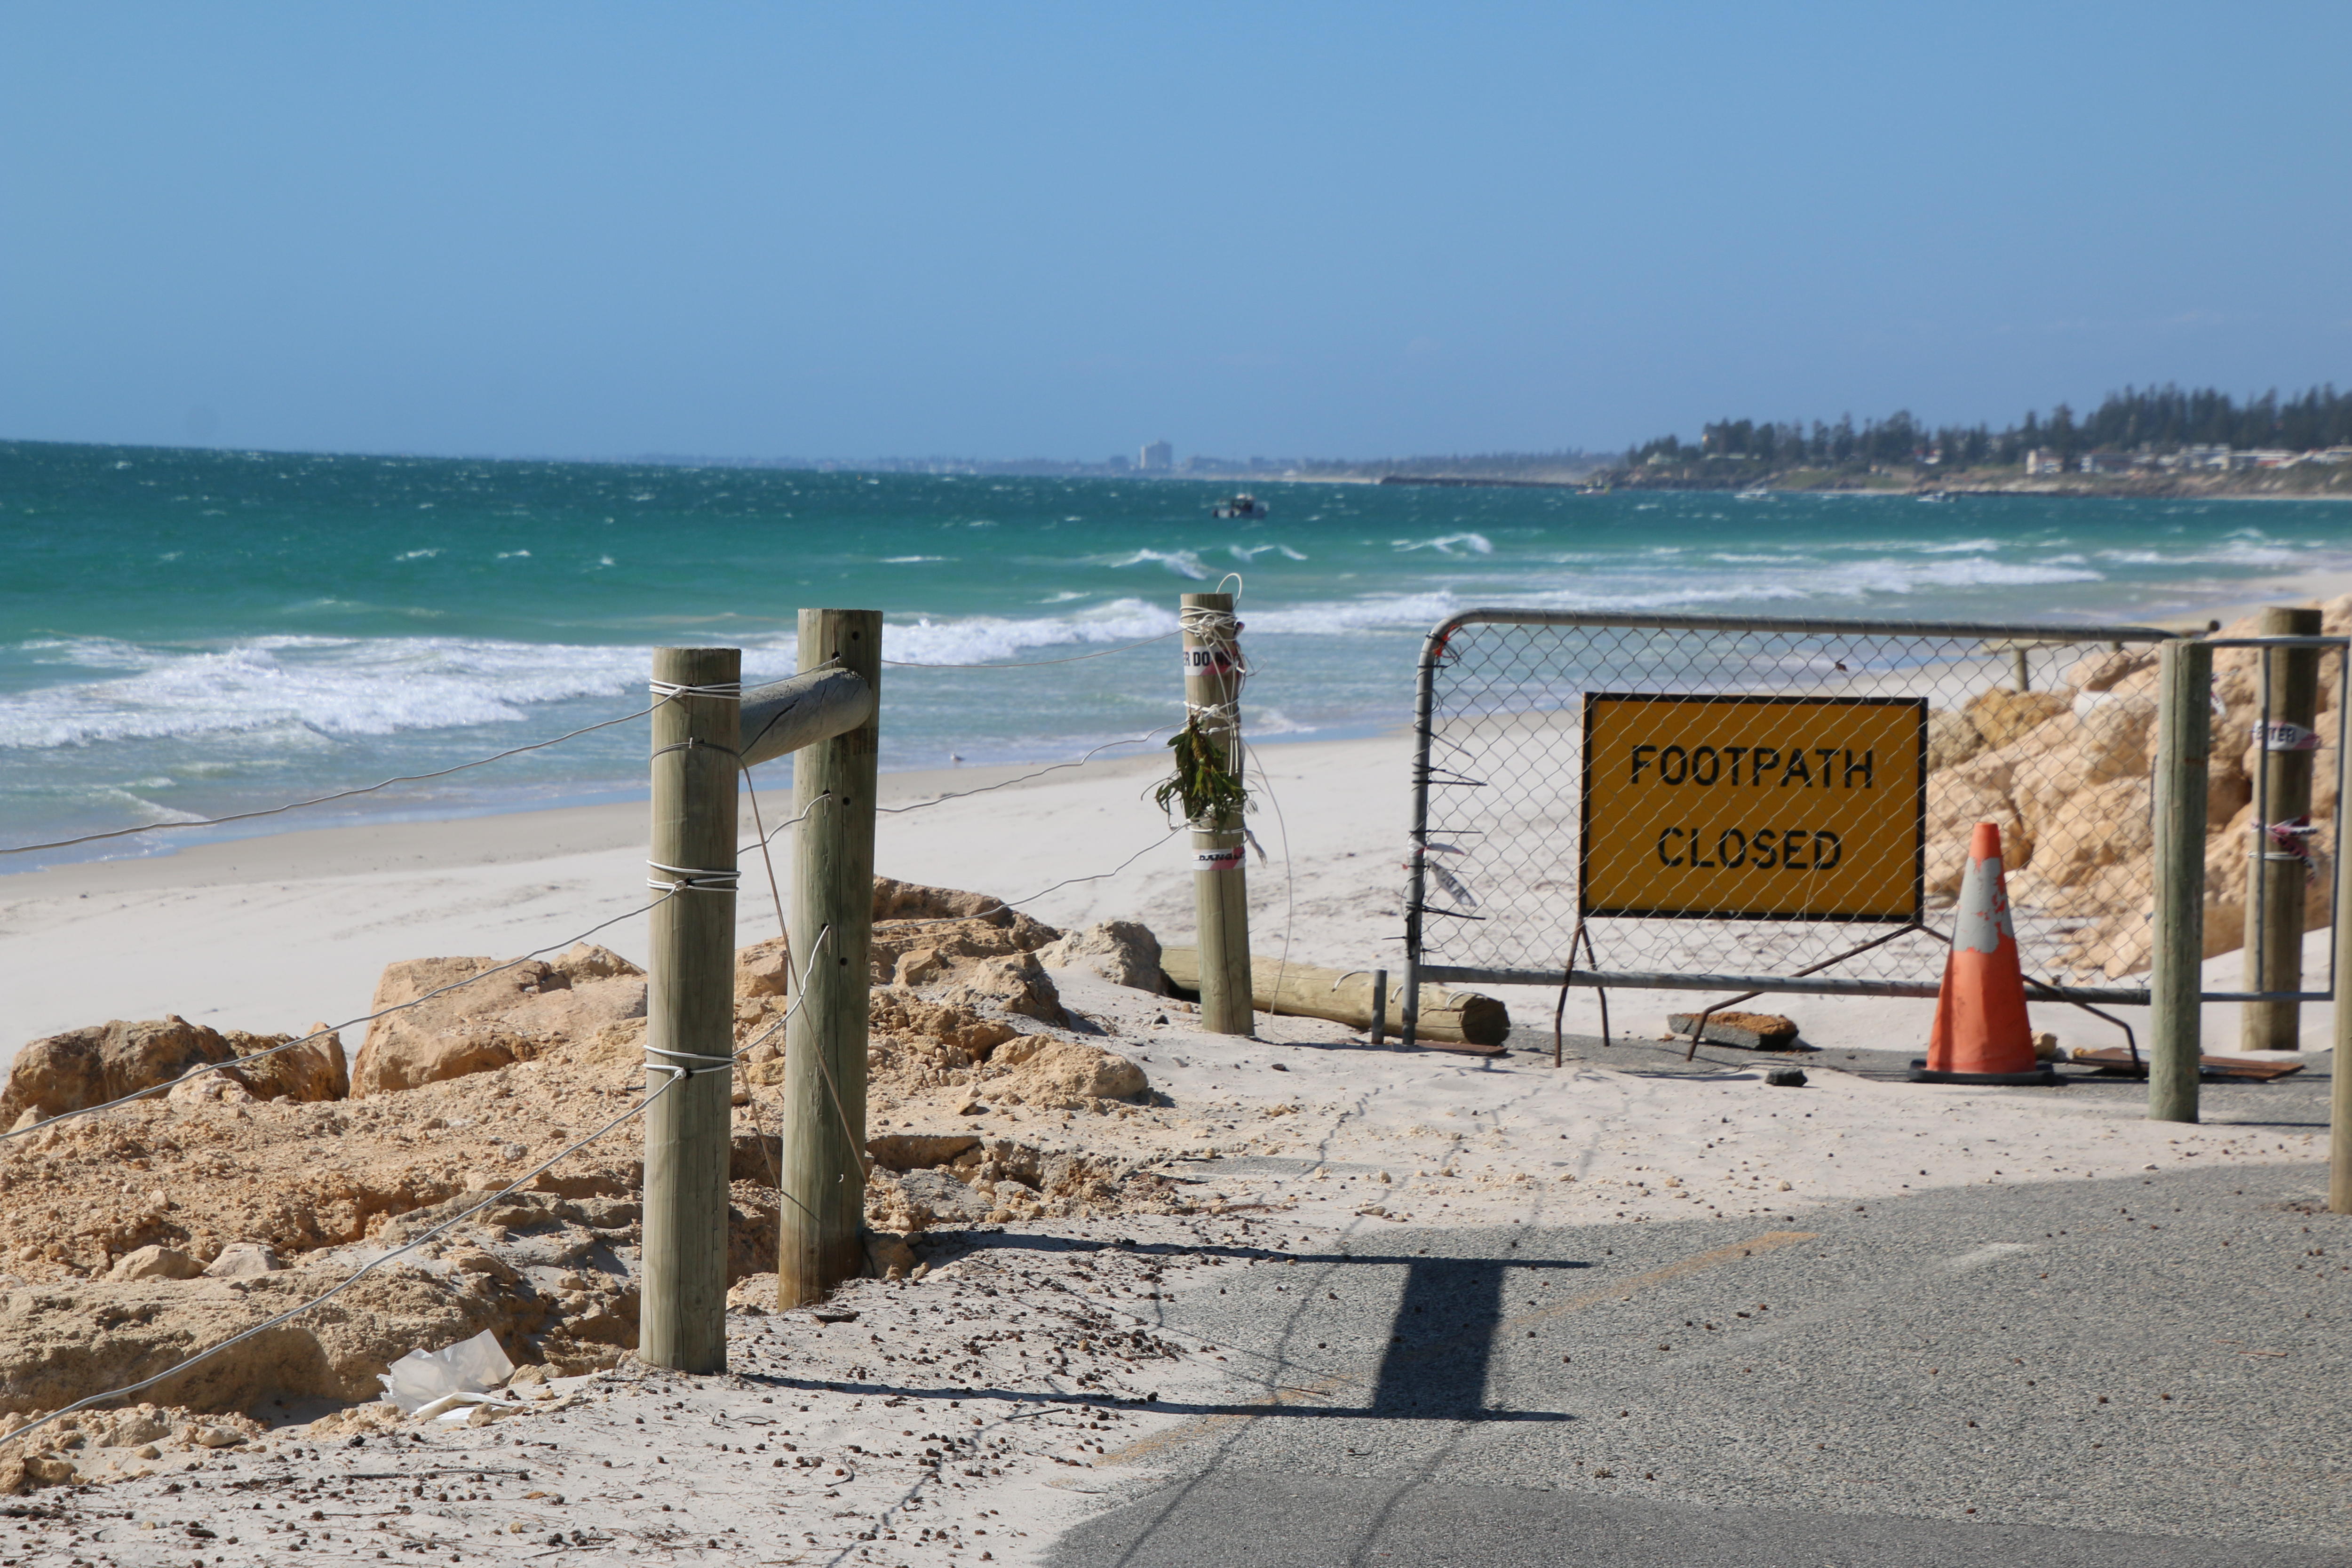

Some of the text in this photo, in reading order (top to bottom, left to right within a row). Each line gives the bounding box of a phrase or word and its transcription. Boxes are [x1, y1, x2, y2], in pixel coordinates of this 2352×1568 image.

[1193, 652, 1210, 666] DO
[2256, 726, 2296, 742] ETER
[1631, 745, 1873, 788] FOOTPATH
[1658, 827, 1842, 870] CLOSED
